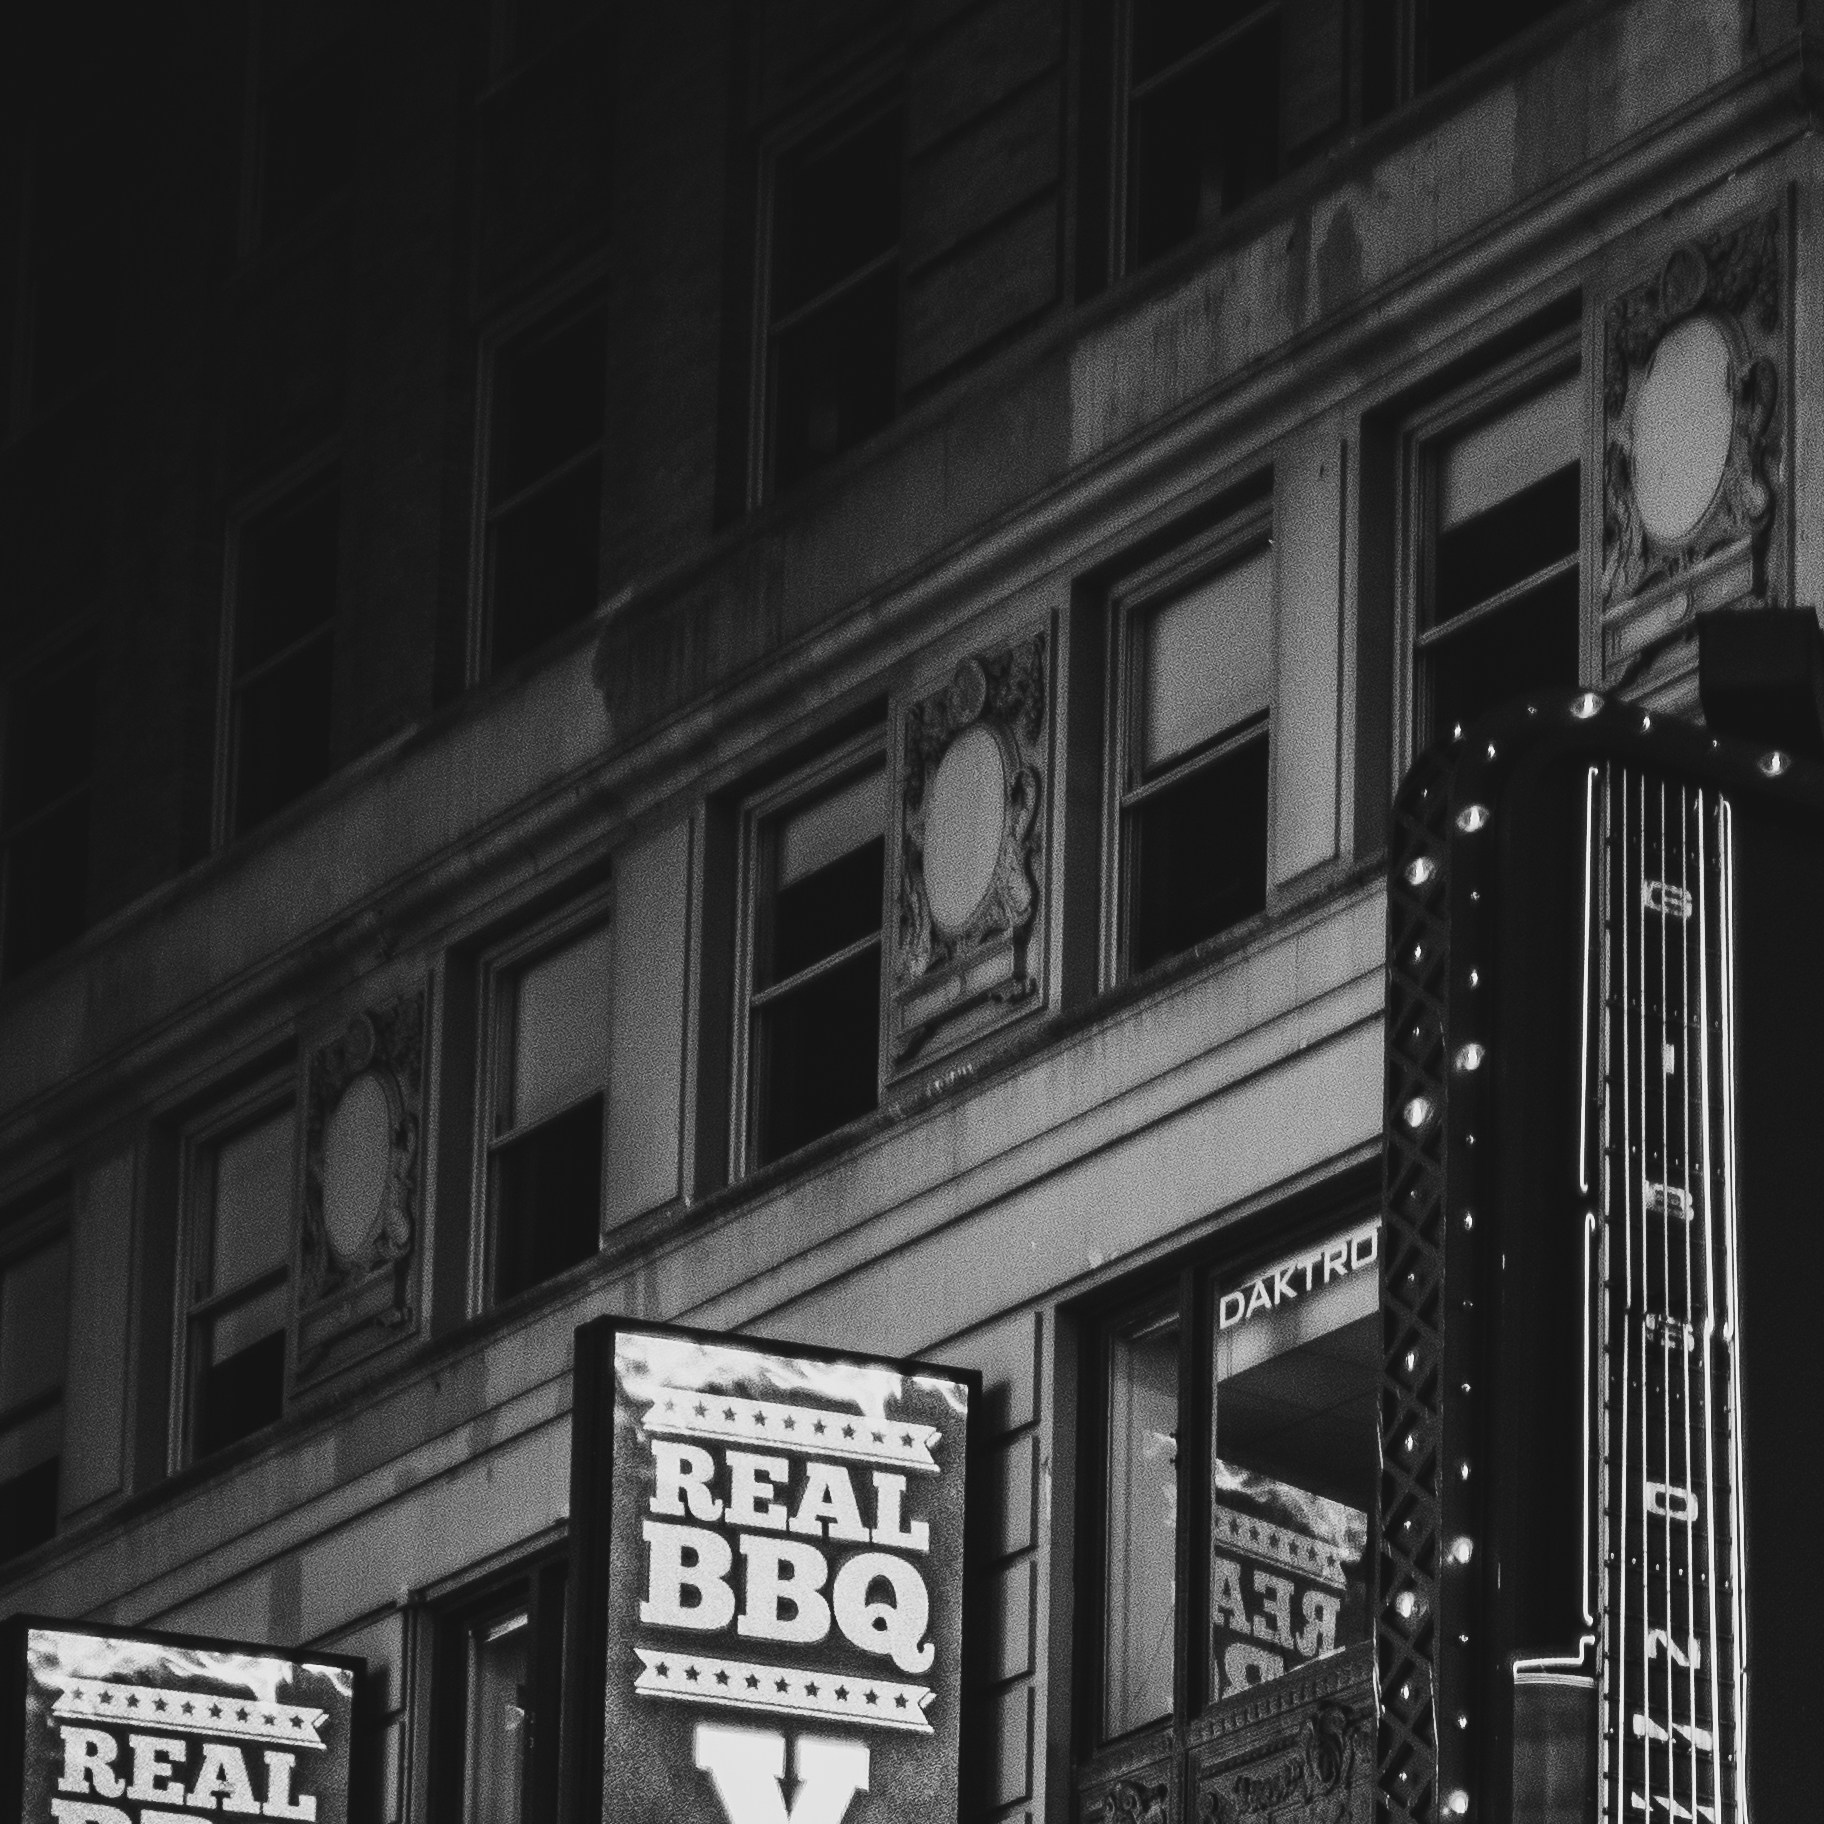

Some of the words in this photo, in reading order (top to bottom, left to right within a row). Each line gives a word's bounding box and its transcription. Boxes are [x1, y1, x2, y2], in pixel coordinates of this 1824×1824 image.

[1217, 1226, 1381, 1331] DAKTRO
[648, 1439, 931, 1551] REAL
[639, 1519, 936, 1674] BBQ
[57, 1724, 317, 1822] REAL
